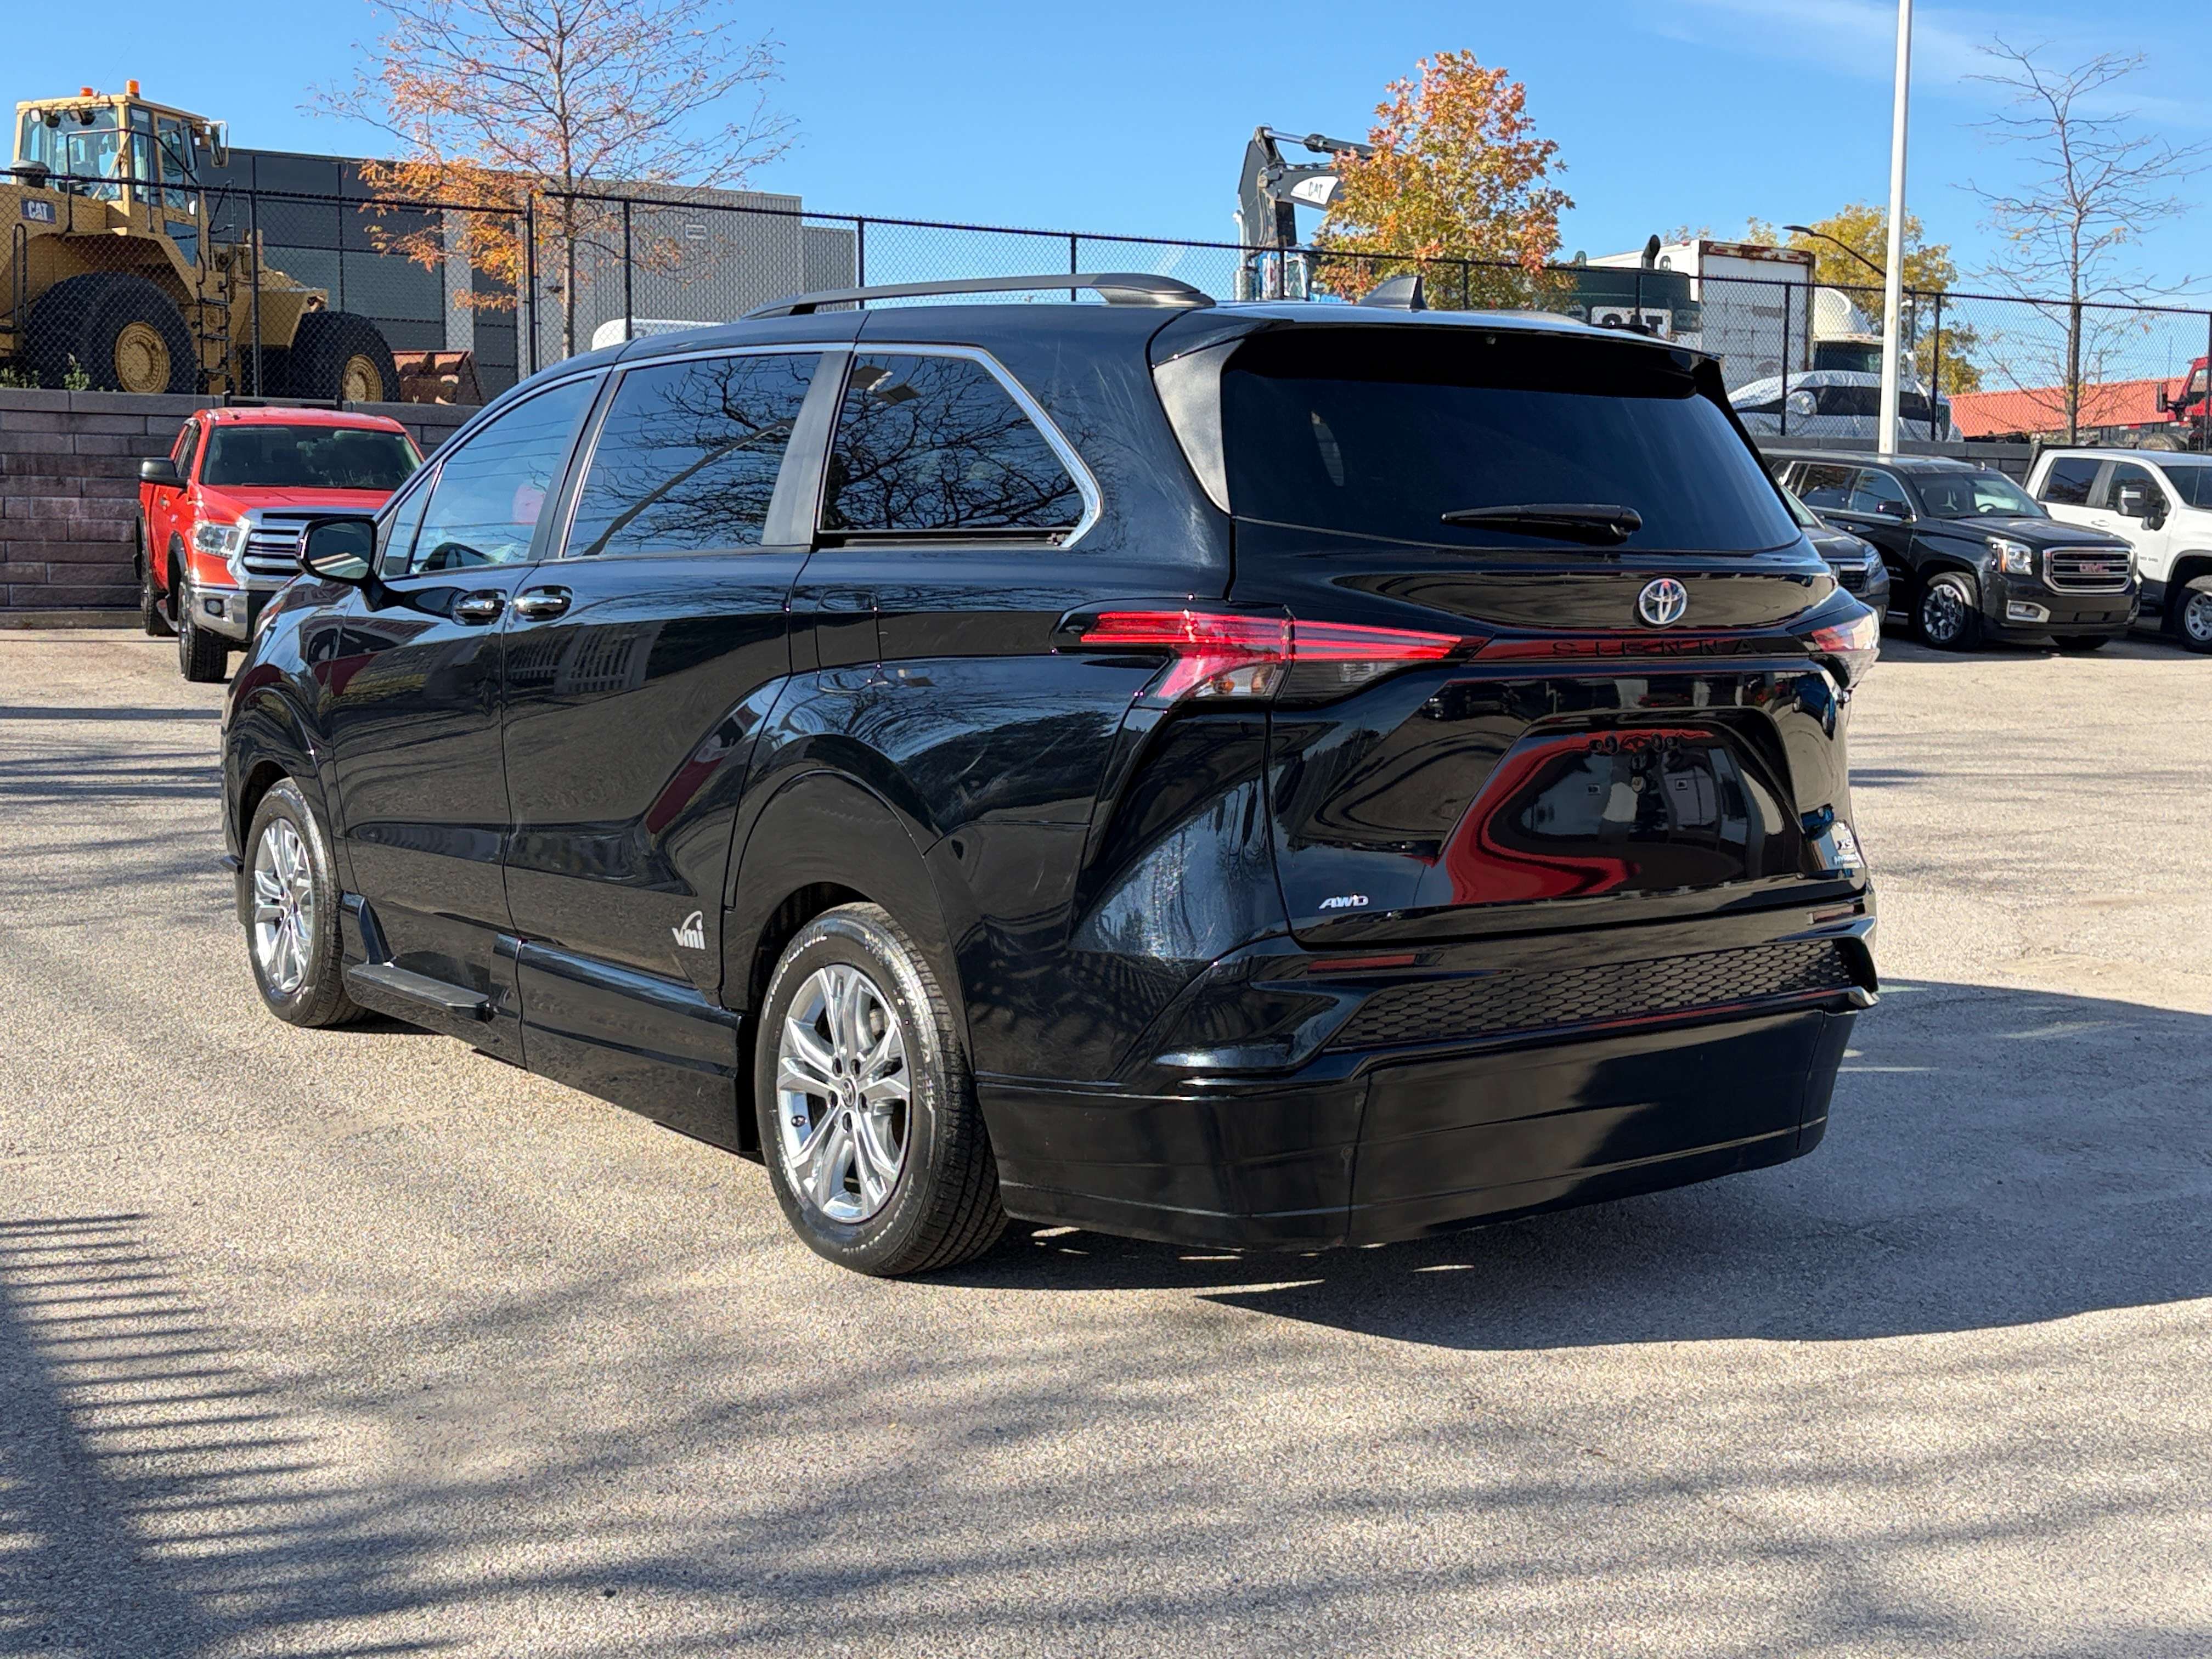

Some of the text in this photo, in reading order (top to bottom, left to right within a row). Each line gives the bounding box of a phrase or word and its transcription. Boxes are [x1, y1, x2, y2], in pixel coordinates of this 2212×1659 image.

[1308, 182, 1323, 200] CAT
[28, 200, 48, 221] CAT
[1552, 638, 1758, 656] SIENNA
[1318, 895, 1369, 909] AWD
